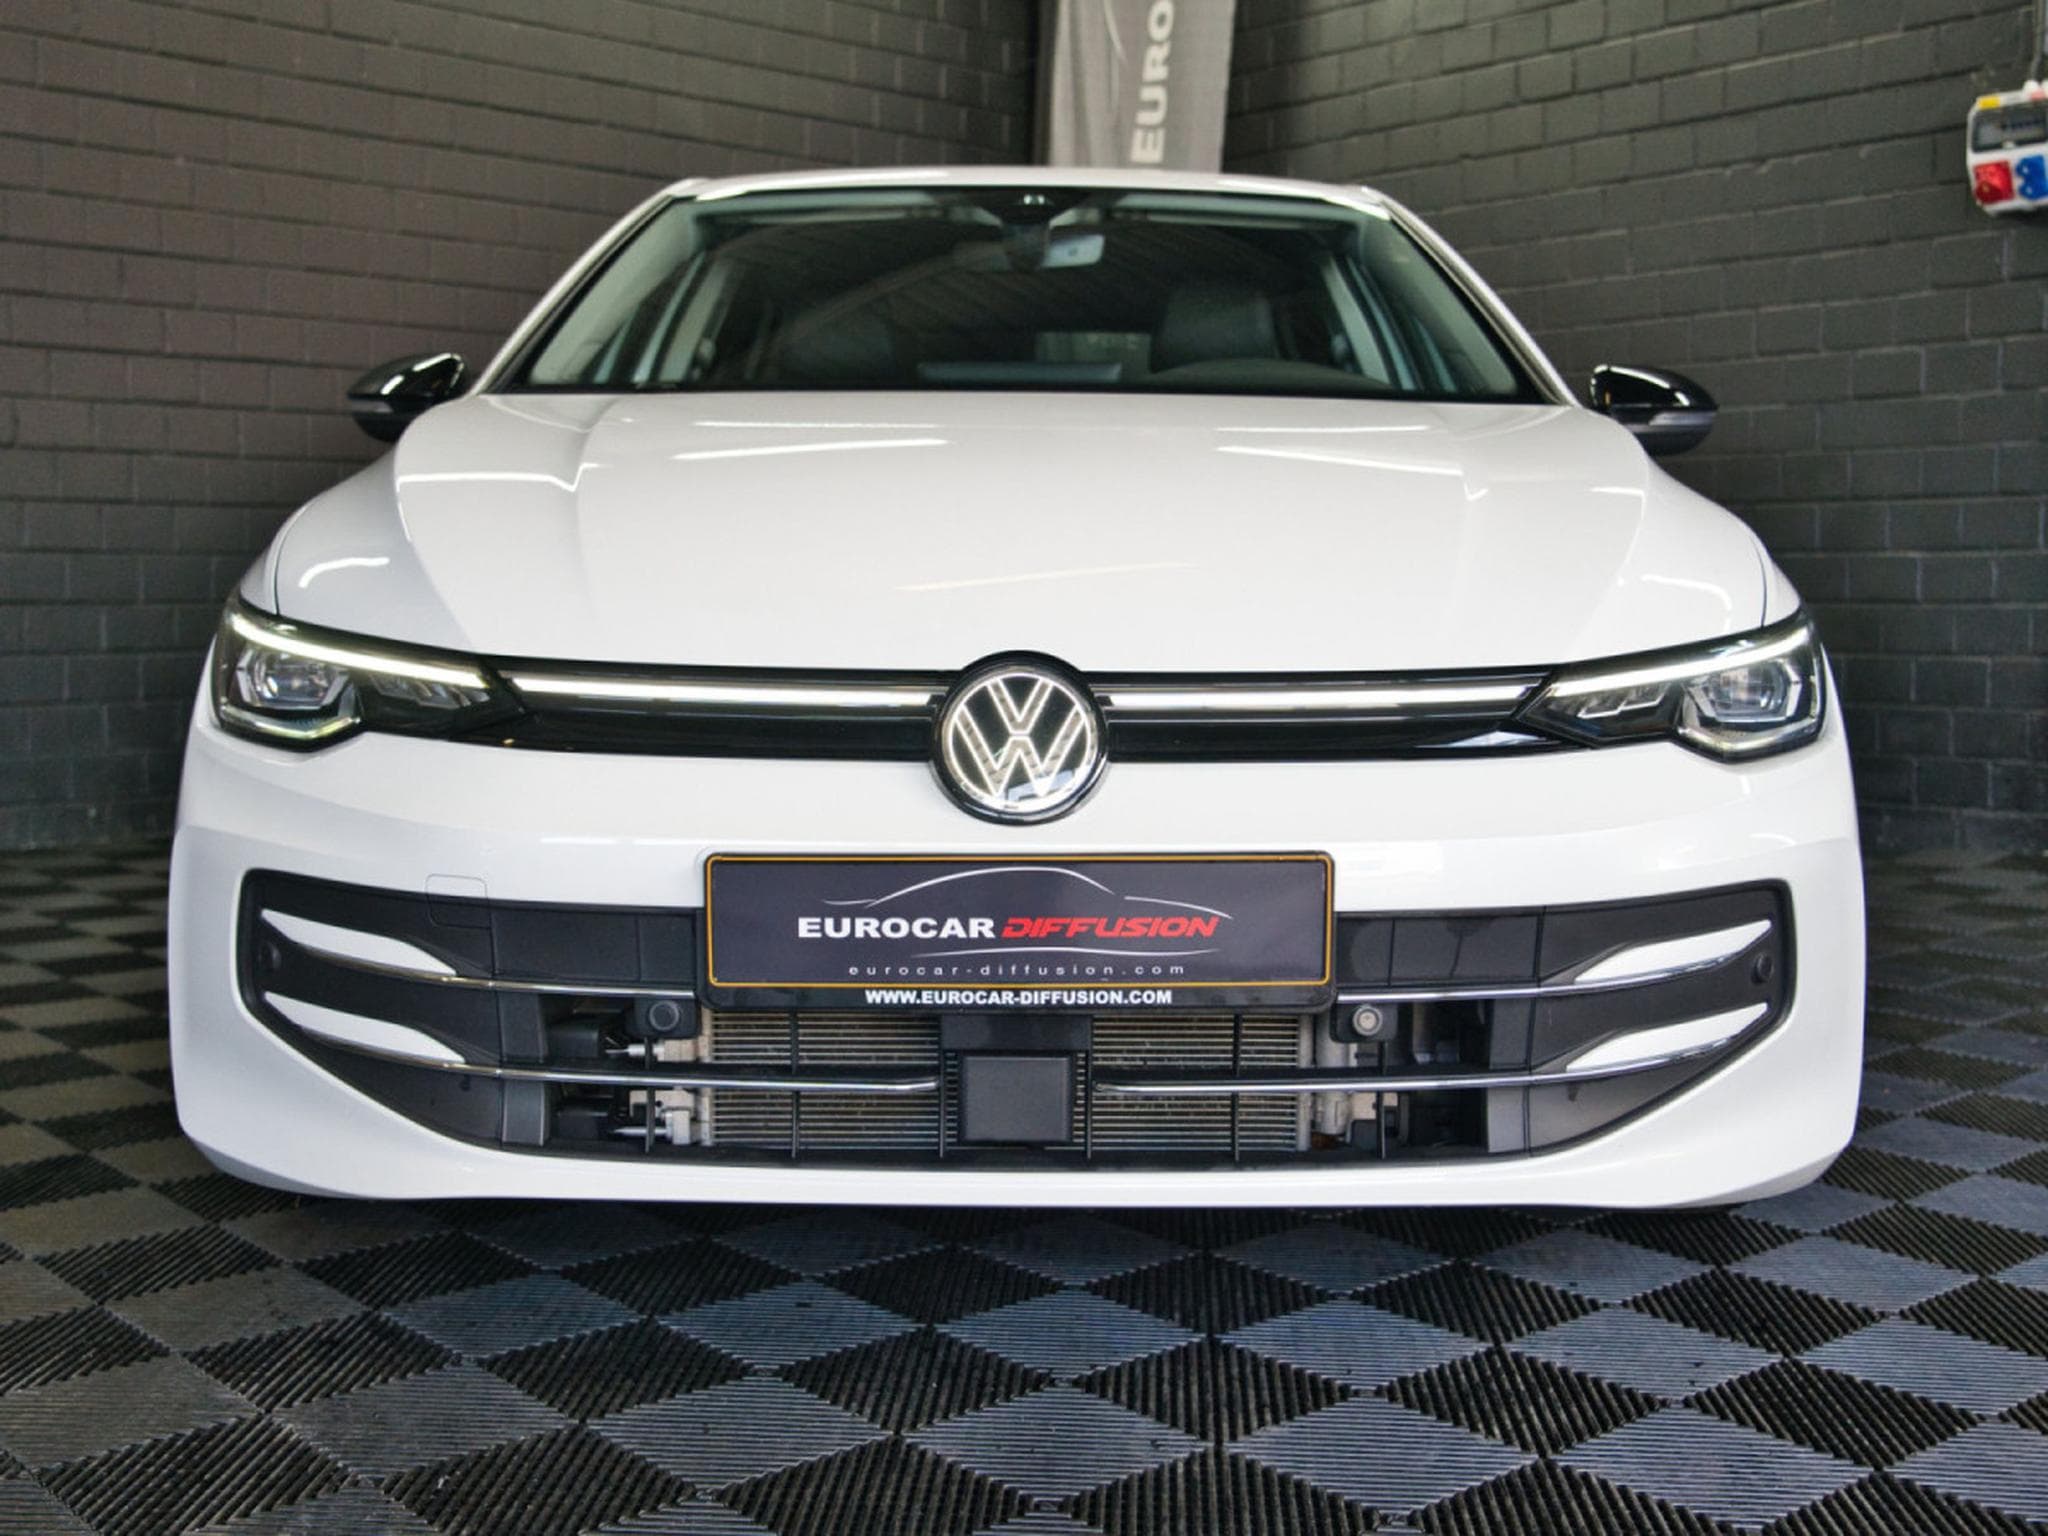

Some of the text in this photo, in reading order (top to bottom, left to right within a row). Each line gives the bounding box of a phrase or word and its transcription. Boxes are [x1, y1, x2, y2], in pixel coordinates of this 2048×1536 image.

[1131, 0, 1174, 163] EURO
[797, 917, 1219, 939] EUROCAR DIFFUSION
[849, 965, 1184, 976] eurocar-diffusion.com
[865, 990, 1172, 1004] WWW.EUROCAR-DIFFUSION.COM
